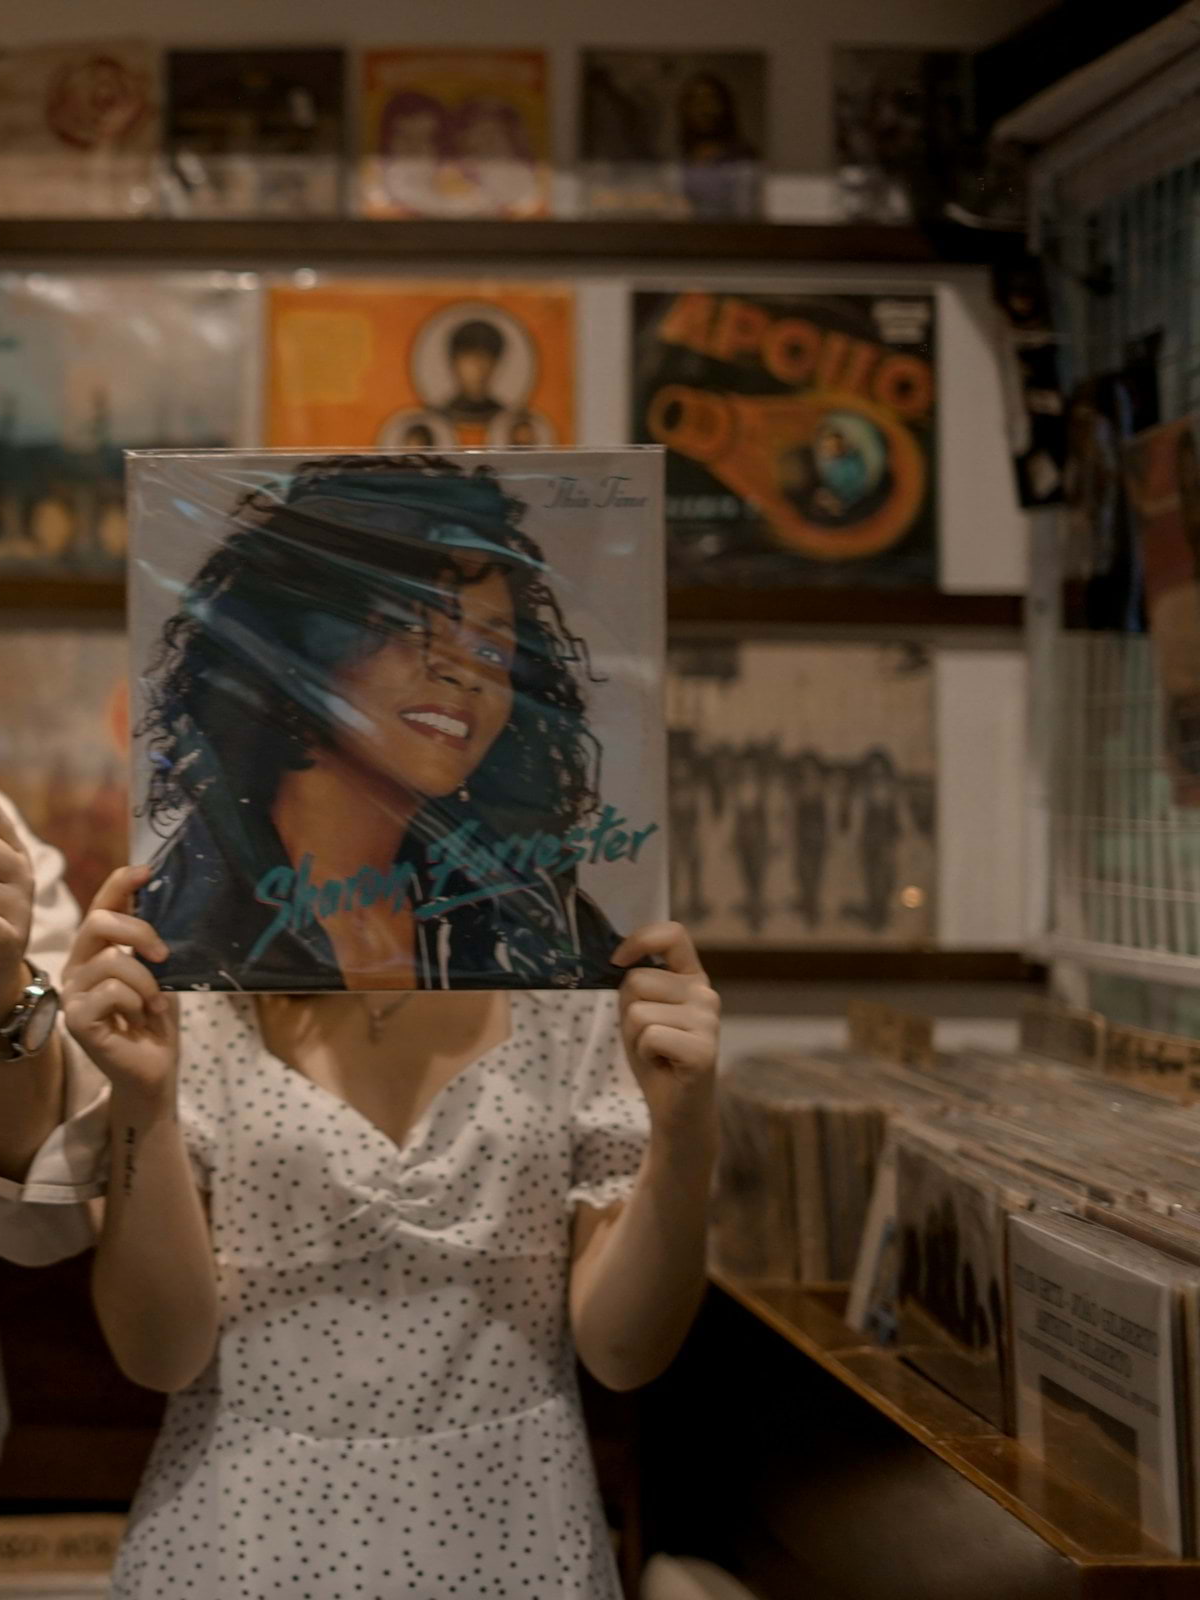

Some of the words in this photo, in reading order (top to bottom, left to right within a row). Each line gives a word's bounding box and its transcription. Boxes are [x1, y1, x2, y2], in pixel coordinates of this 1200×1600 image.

[657, 289, 933, 419] APOLLO
[593, 475, 648, 508] Time
[241, 852, 414, 968] Sharon
[415, 805, 657, 918] Forrester
